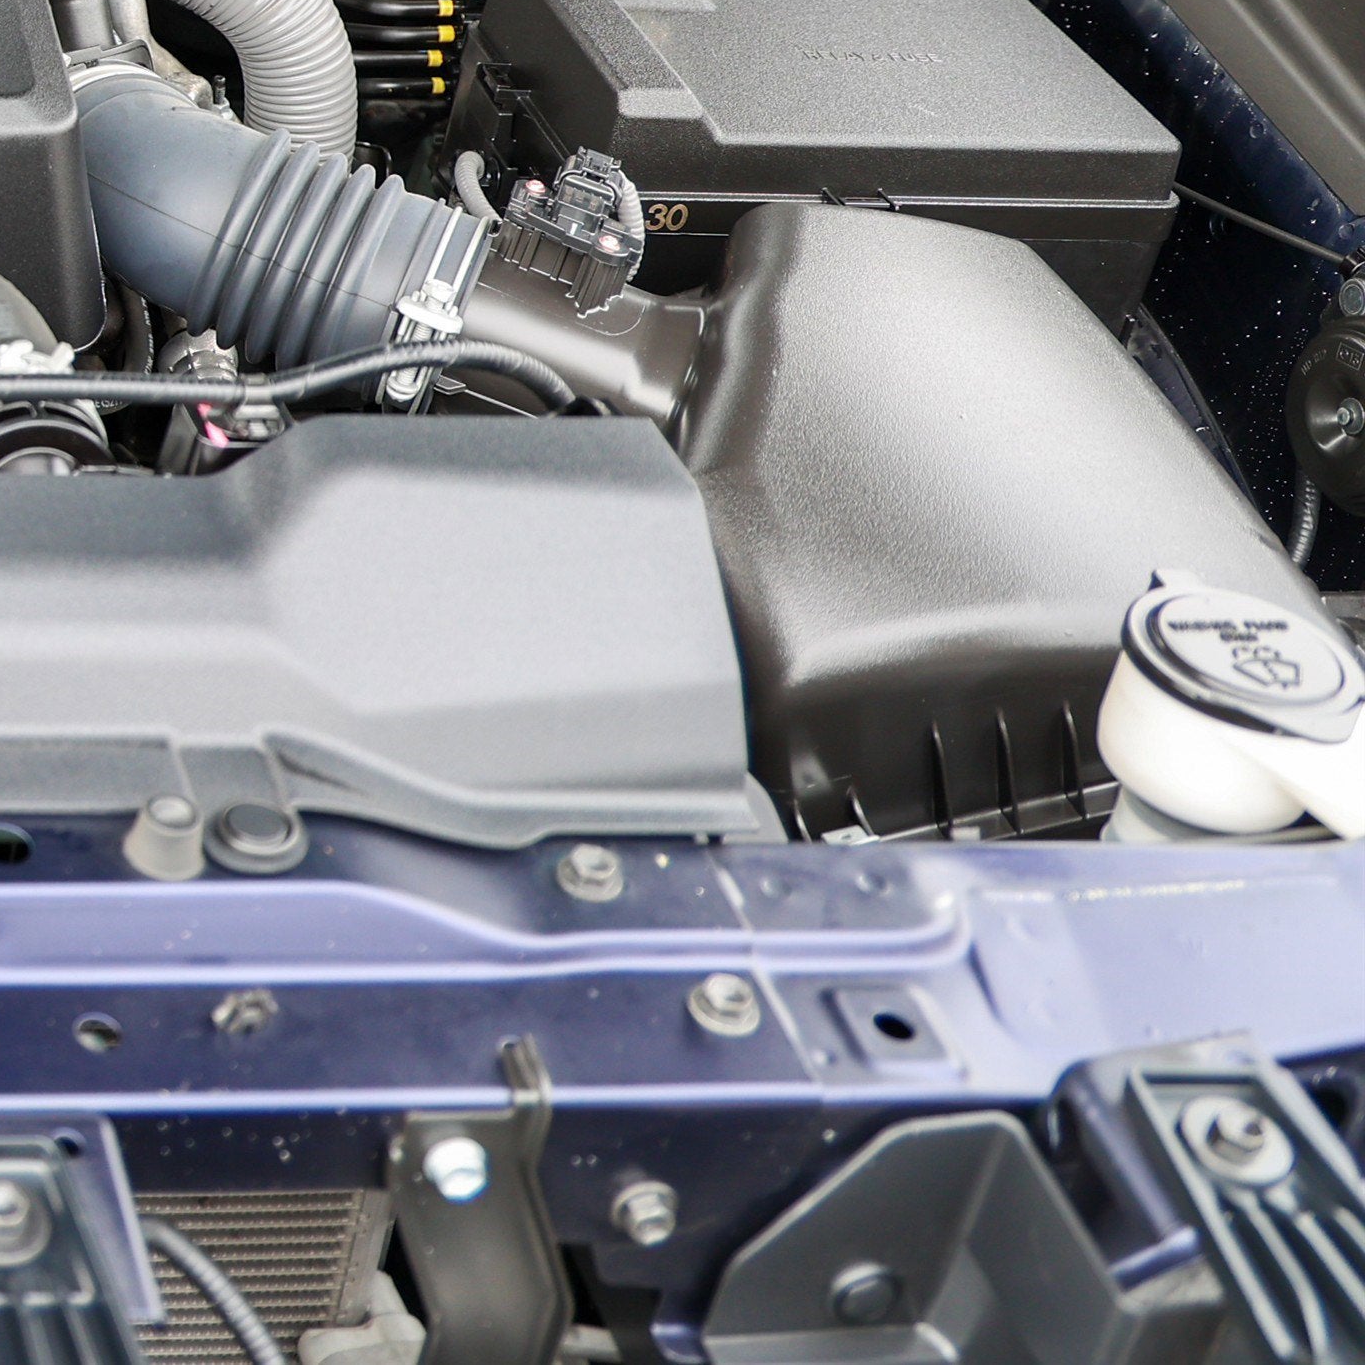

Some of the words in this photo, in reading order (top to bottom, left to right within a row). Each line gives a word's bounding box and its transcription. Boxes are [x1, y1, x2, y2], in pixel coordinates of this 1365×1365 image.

[801, 50, 865, 62] RELAY
[887, 52, 943, 63] FUSE
[645, 203, 689, 231] 30
